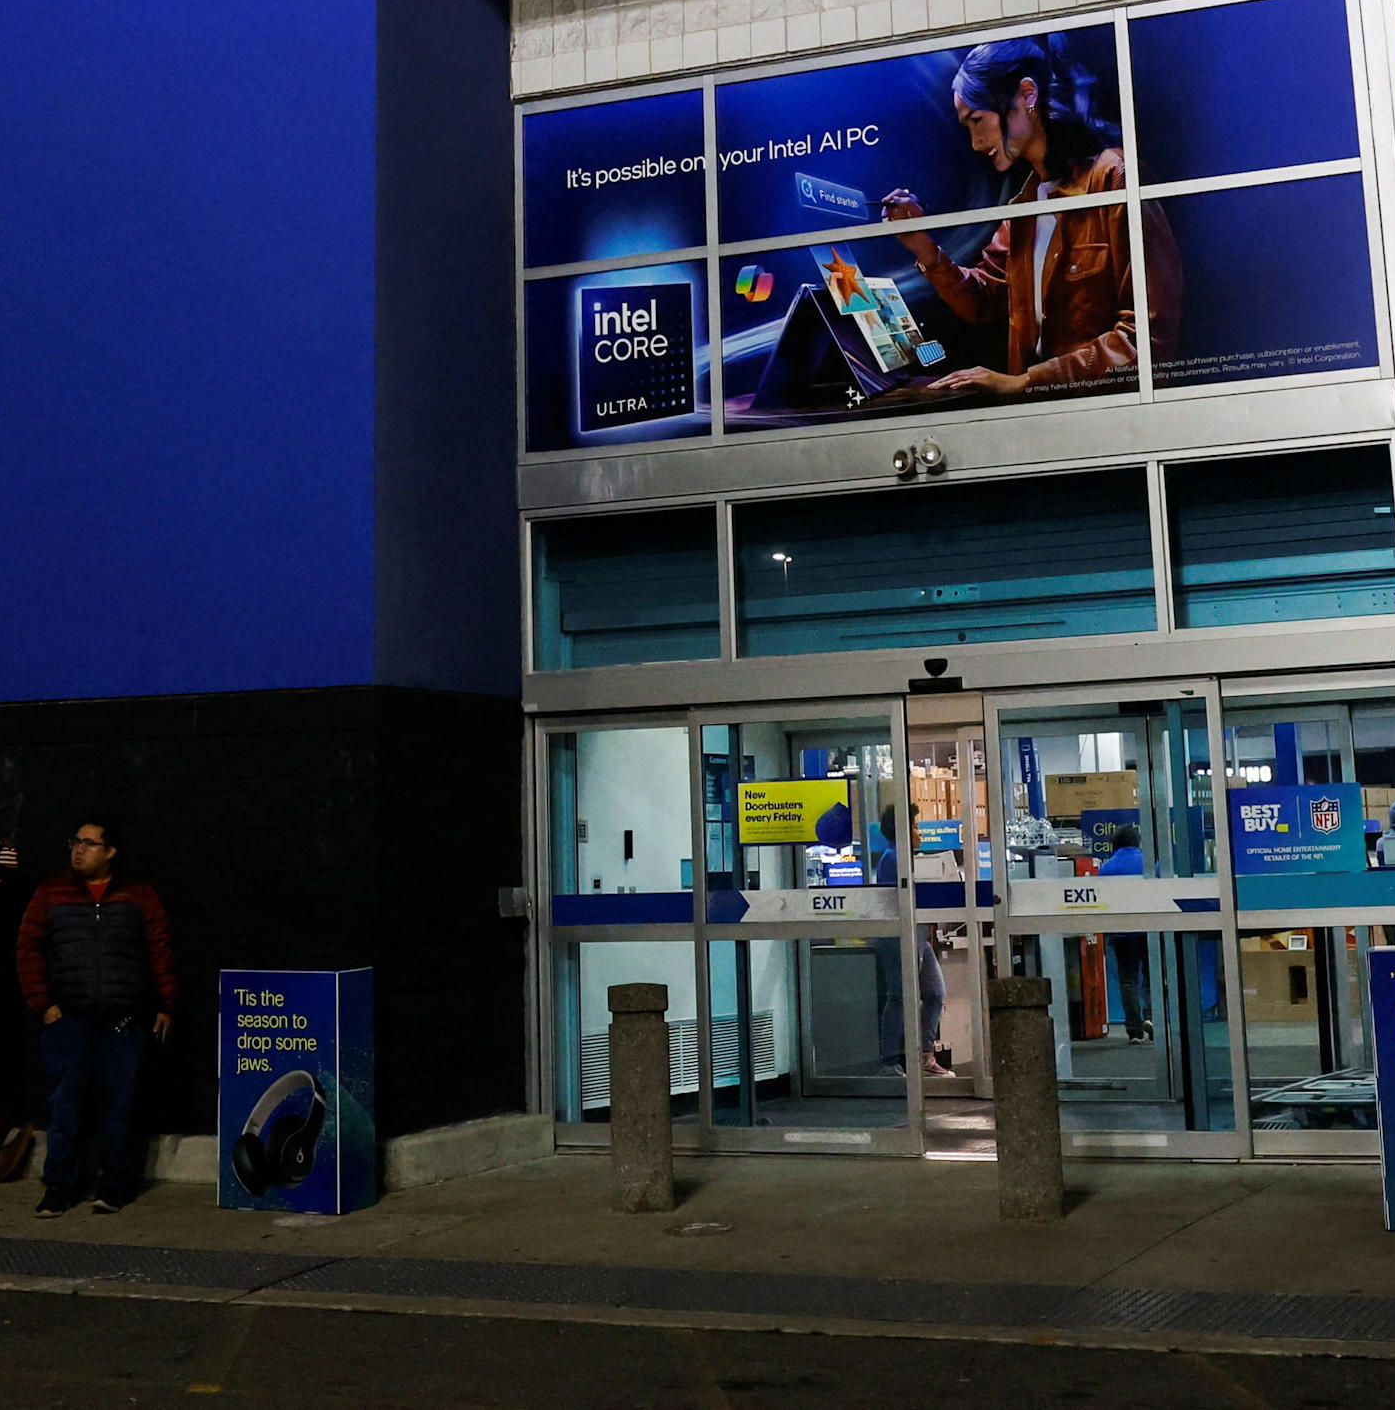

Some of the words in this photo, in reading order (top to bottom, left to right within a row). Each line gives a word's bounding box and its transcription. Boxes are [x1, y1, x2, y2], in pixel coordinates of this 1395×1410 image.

[567, 168, 592, 188] It's
[595, 157, 677, 188] possible
[681, 155, 706, 172] on
[719, 146, 765, 171] your
[768, 134, 812, 160] Intel
[819, 130, 842, 152] AI
[846, 125, 880, 148] PC
[819, 189, 835, 203] Find
[594, 298, 657, 336] intel
[1186, 355, 1219, 365] software
[1050, 382, 1067, 390] have
[596, 396, 648, 417] ULTRA
[744, 790, 766, 800] New
[744, 801, 804, 812] Doorbusters
[1240, 804, 1281, 819] BEST
[745, 814, 772, 823] every
[773, 812, 804, 823] Friday.
[1244, 818, 1279, 832] BUY
[1314, 813, 1338, 829] NFL
[812, 895, 846, 910] EXIT
[261, 988, 285, 1007] the
[237, 1014, 288, 1029] season
[292, 1014, 307, 1029] to
[237, 1032, 271, 1053] drop
[275, 1035, 317, 1052] some
[237, 1054, 273, 1074] jaws.
